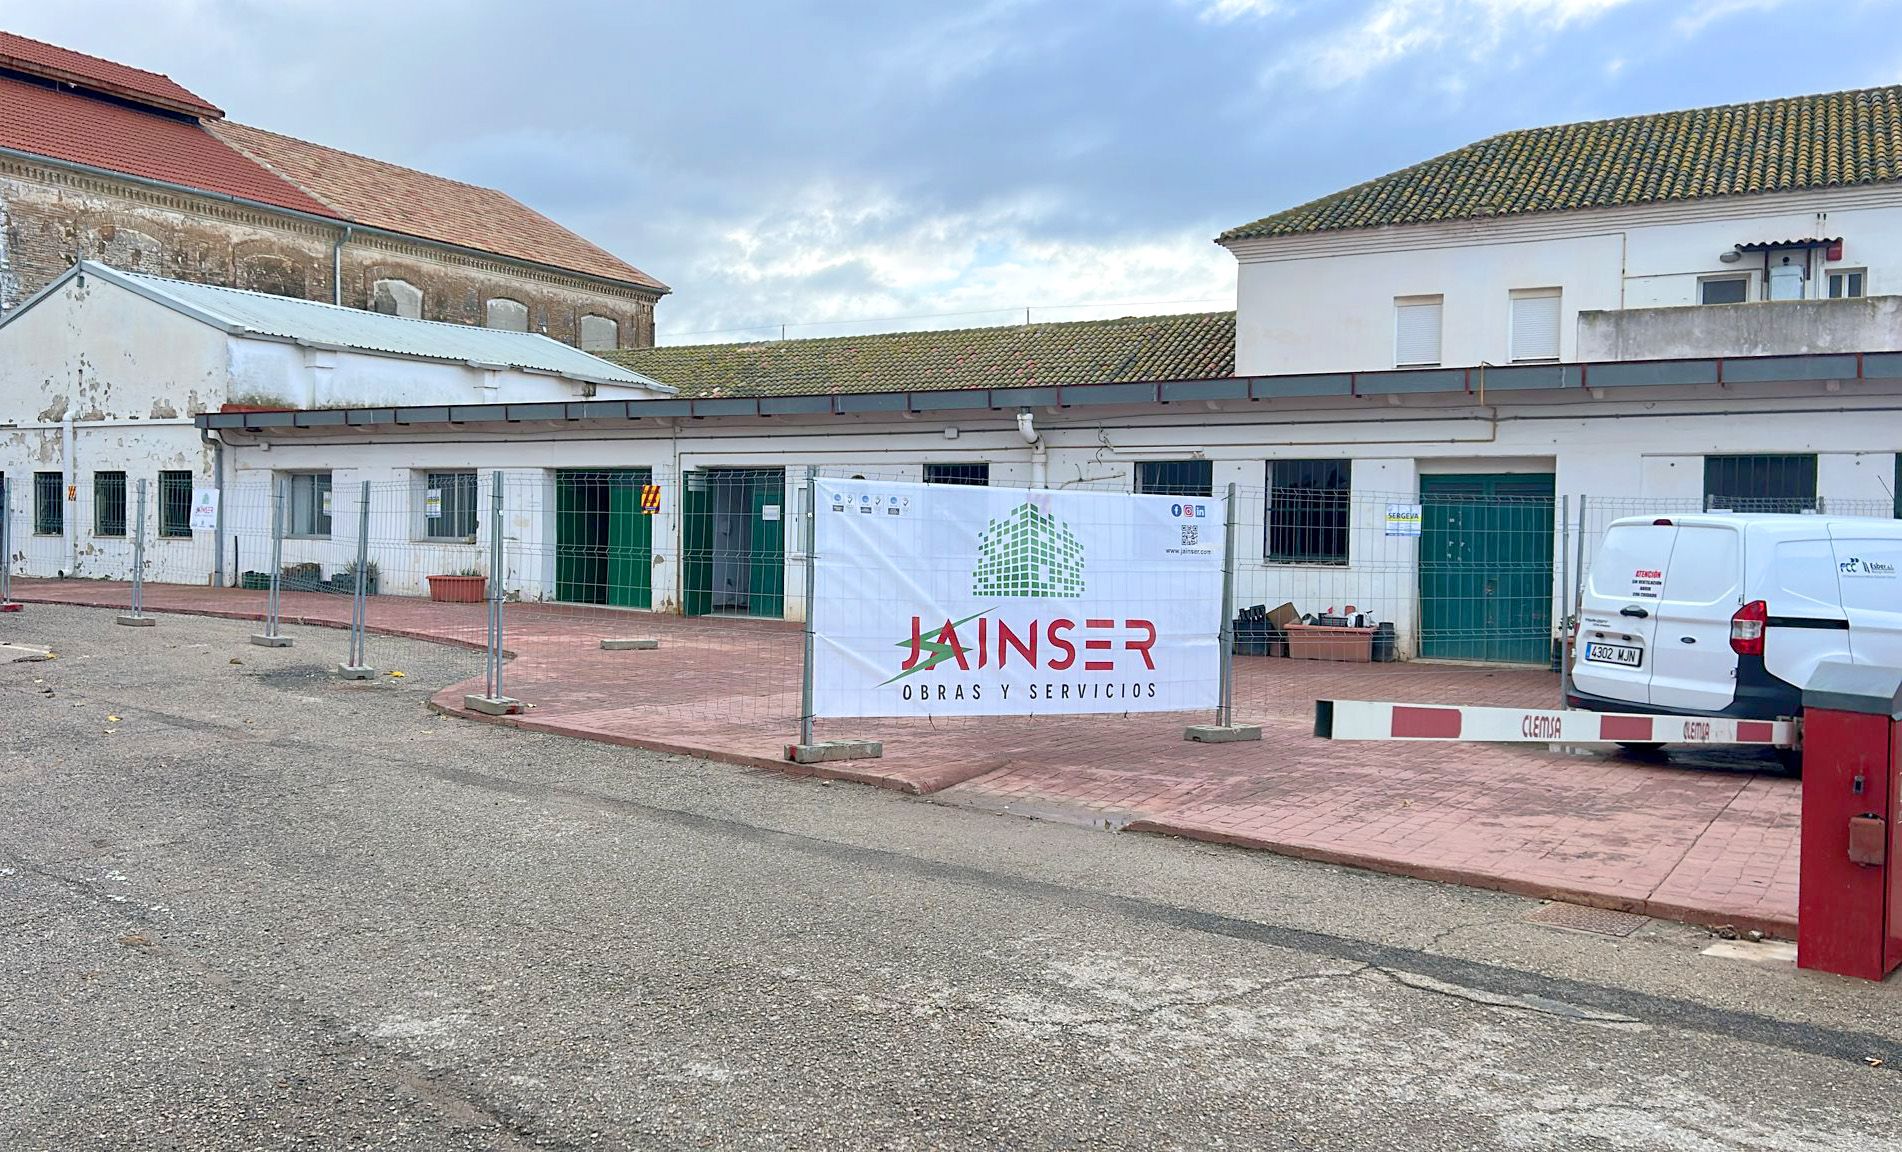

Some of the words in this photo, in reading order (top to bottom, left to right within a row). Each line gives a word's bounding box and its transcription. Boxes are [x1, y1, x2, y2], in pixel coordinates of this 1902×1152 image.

[901, 616, 1157, 671] JAINSER
[1591, 646, 1614, 660] 4302
[1617, 649, 1636, 662] MJN
[902, 684, 981, 700] OBRAS
[1001, 684, 1010, 699] Y
[1029, 682, 1156, 699] SERVICIOS
[1522, 714, 1562, 738] CLEMSA
[1682, 720, 1710, 740] CLEMSA
